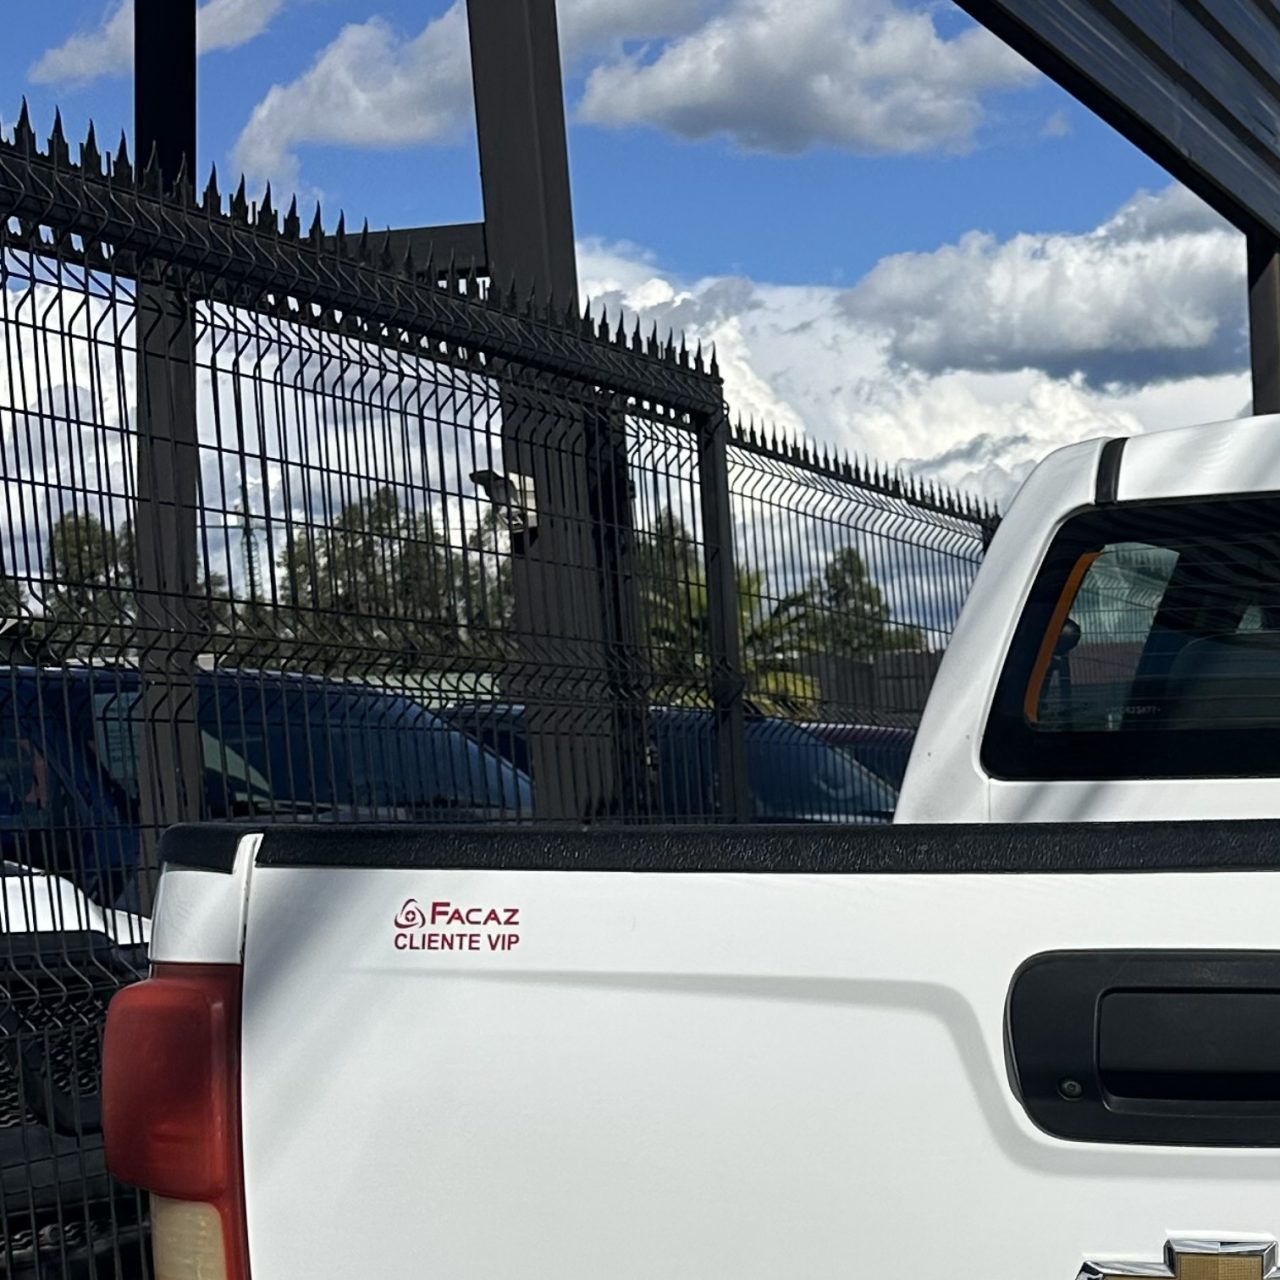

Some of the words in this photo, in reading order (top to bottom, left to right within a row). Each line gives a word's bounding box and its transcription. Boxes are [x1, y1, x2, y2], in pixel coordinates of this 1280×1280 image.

[430, 901, 519, 925] FACAZ
[394, 933, 481, 951] CLIENTE
[488, 933, 520, 951] VIP
